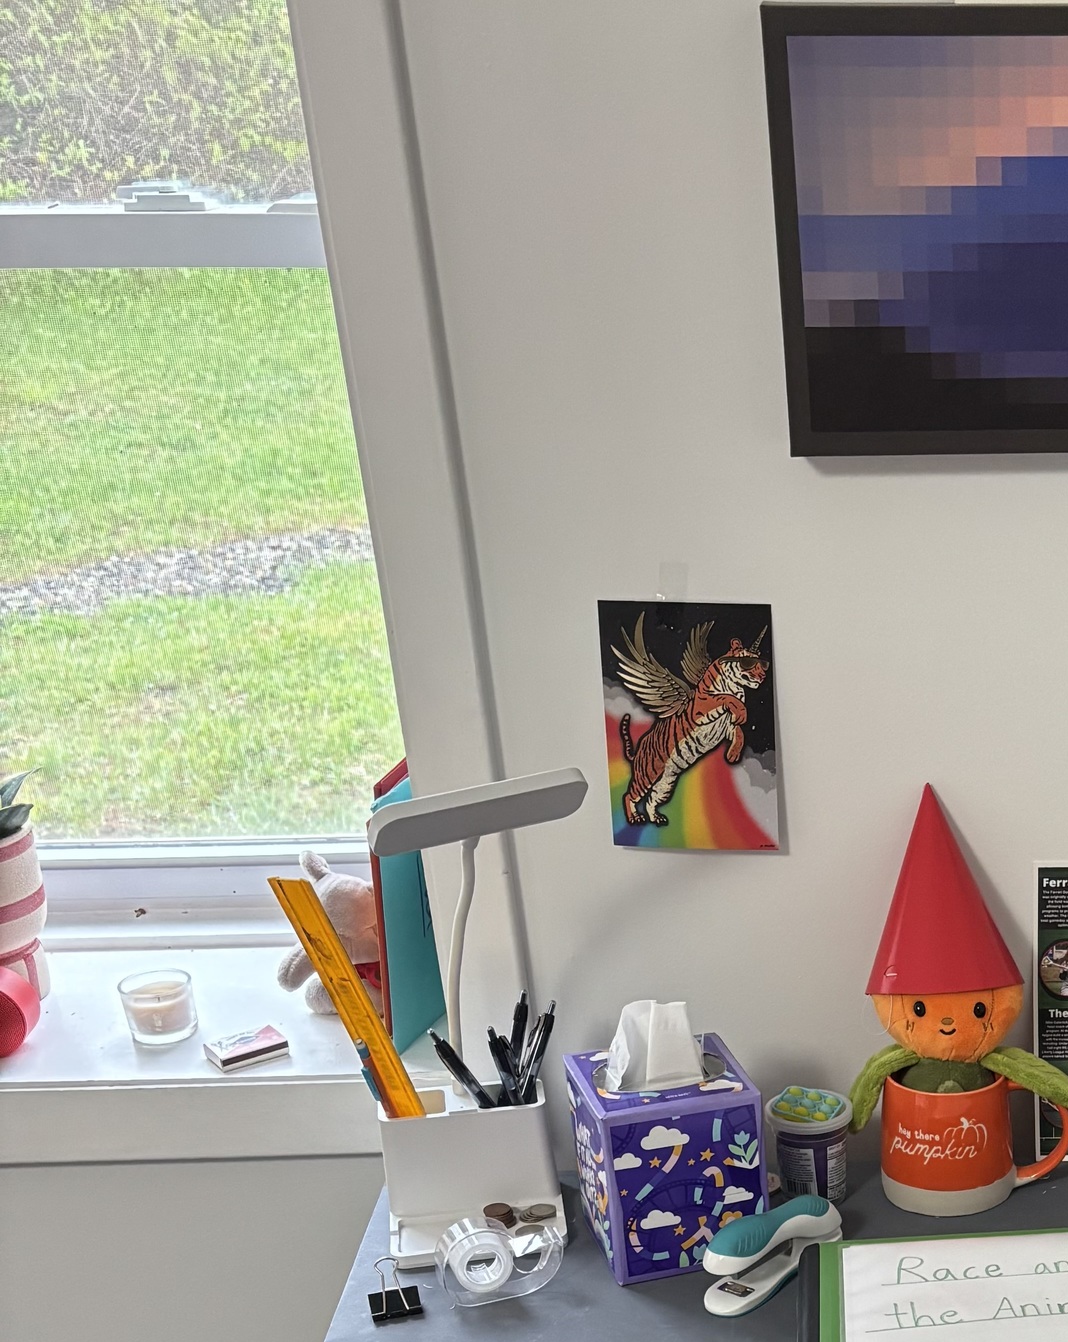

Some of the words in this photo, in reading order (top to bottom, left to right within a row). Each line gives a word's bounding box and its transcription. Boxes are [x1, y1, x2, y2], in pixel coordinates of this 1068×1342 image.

[1048, 1009, 1068, 1018] The
[914, 1129, 940, 1142] there
[890, 1136, 978, 1166] pumpkin
[896, 1256, 1002, 1285] Race
[884, 1300, 965, 1330] the
